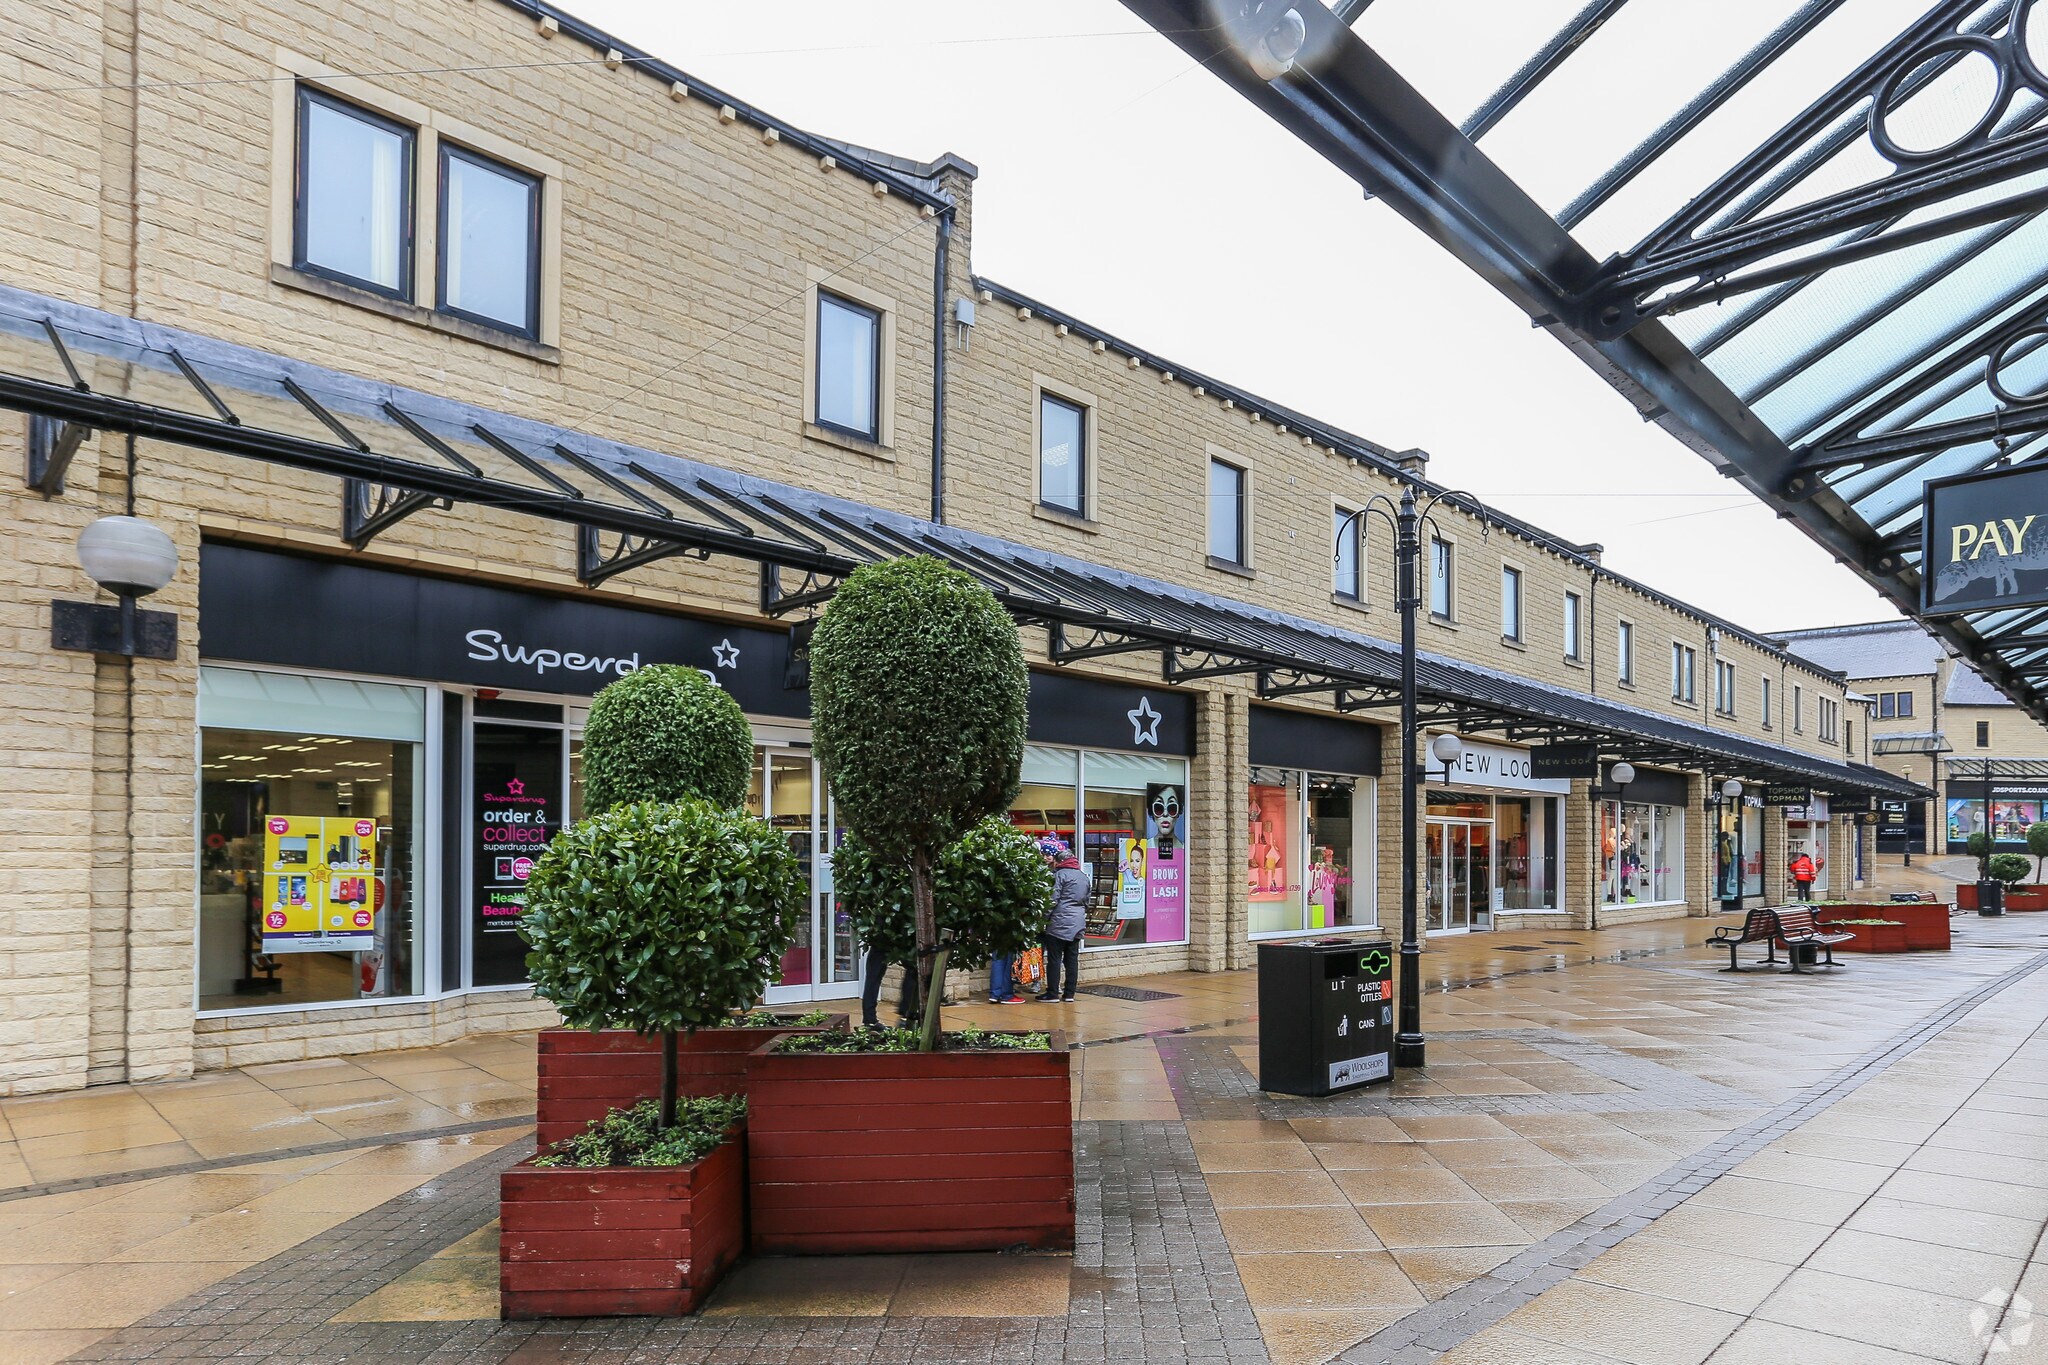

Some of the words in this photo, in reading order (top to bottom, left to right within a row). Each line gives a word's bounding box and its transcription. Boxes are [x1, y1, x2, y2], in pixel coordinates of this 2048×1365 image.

[1950, 514, 2036, 563] PAY
[1538, 758, 1560, 766] NEW
[1564, 757, 1592, 766] LOOK
[1500, 757, 1531, 779] LOO
[1767, 786, 1806, 795] TOPSHOP
[483, 793, 547, 805] Superdrug
[483, 808, 532, 823] order
[535, 809, 547, 824] &
[483, 824, 546, 842] collect
[1152, 868, 1179, 880] BROWS
[1152, 886, 1179, 898] LASH
[1357, 981, 1381, 993] PLASTIC
[1360, 992, 1383, 1003] OTTLES
[1358, 1018, 1376, 1030] CANS
[1351, 1058, 1384, 1073] WOOLSHOPS
